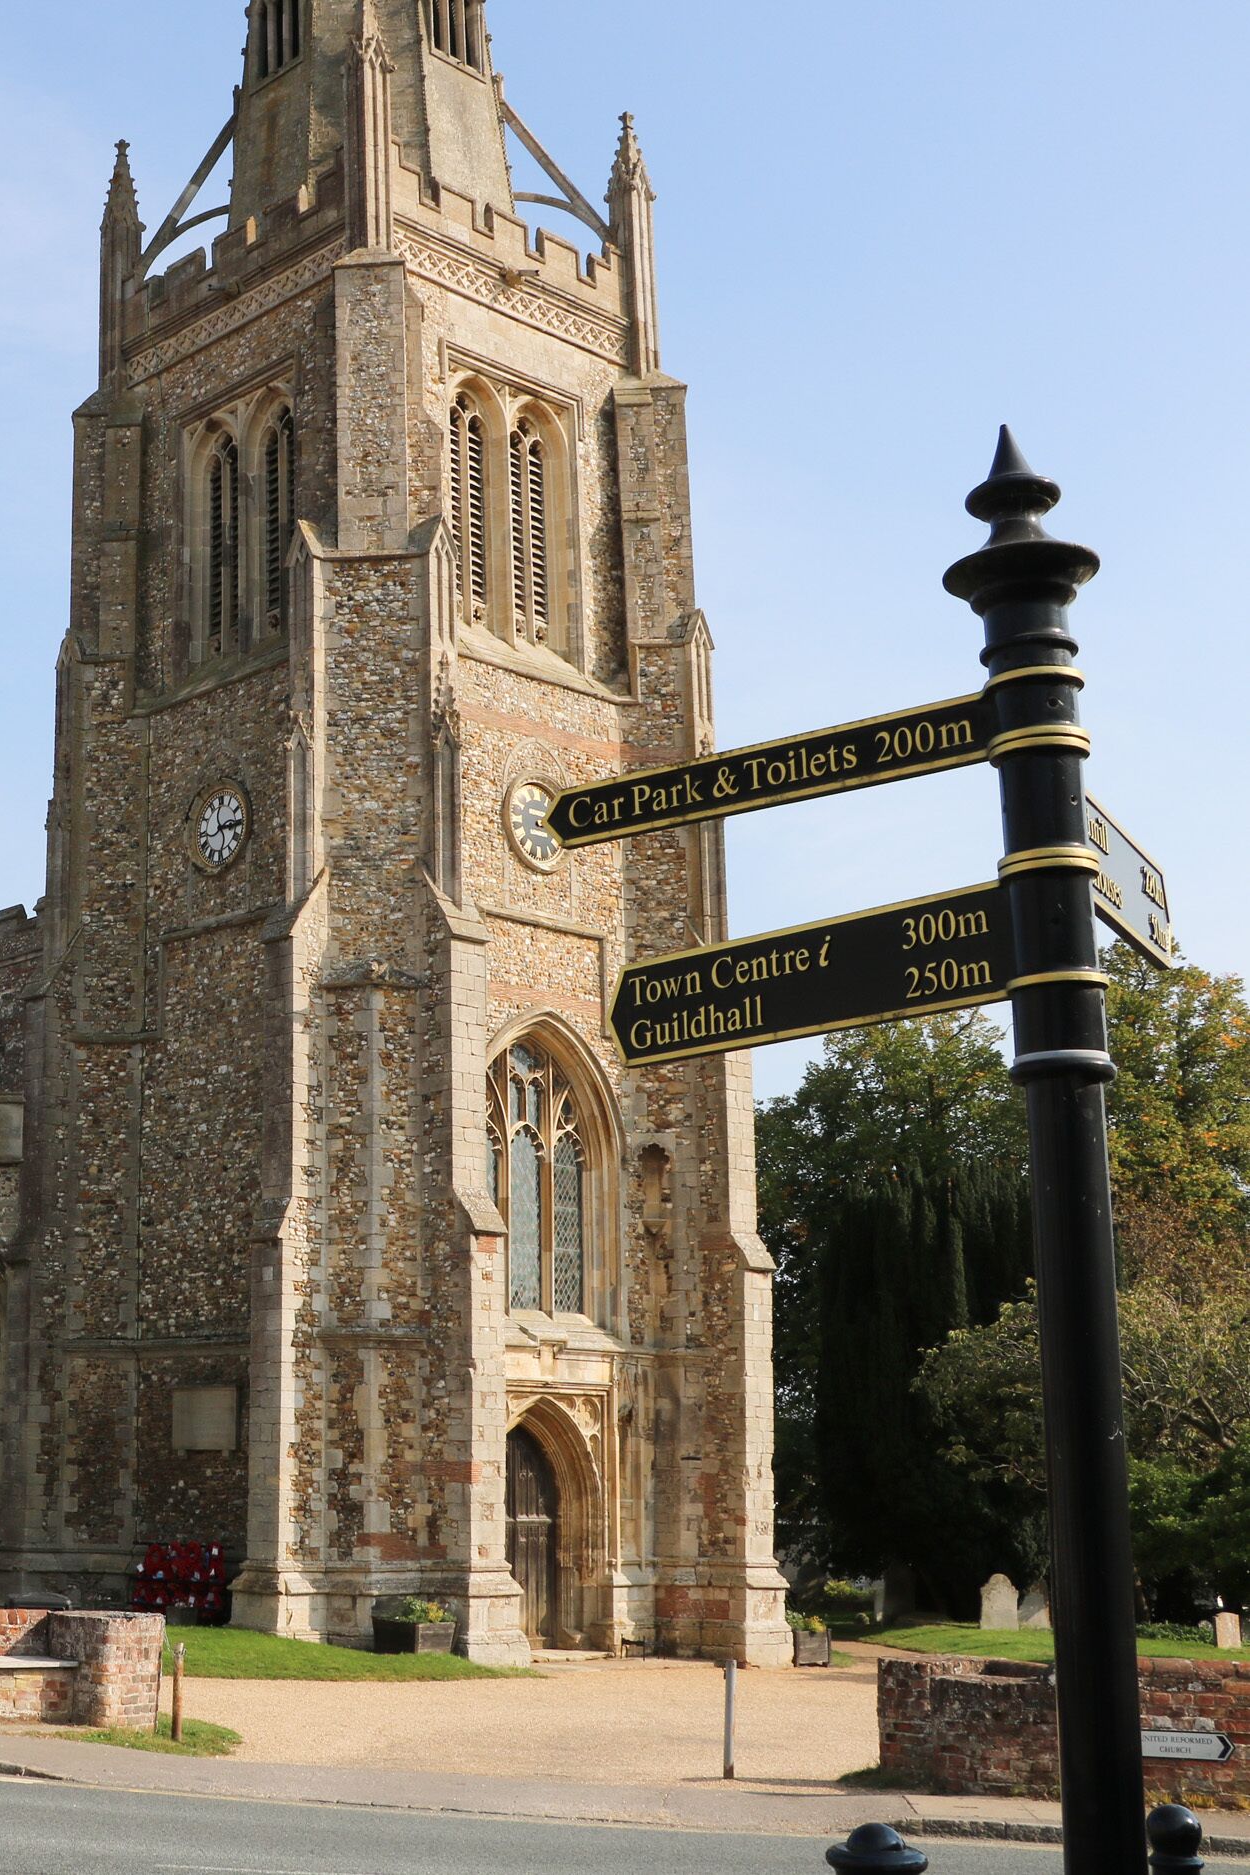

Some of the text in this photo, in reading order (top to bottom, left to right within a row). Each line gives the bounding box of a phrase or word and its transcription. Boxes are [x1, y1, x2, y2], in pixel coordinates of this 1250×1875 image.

[567, 719, 974, 827] Car Park & Toilets 200m
[628, 909, 990, 1006] Town Centre i 300m
[630, 958, 993, 1050] Guildhall 250m
[1143, 1734, 1213, 1745] NITED REFORMED
[1159, 1745, 1192, 1754] CHURCH
